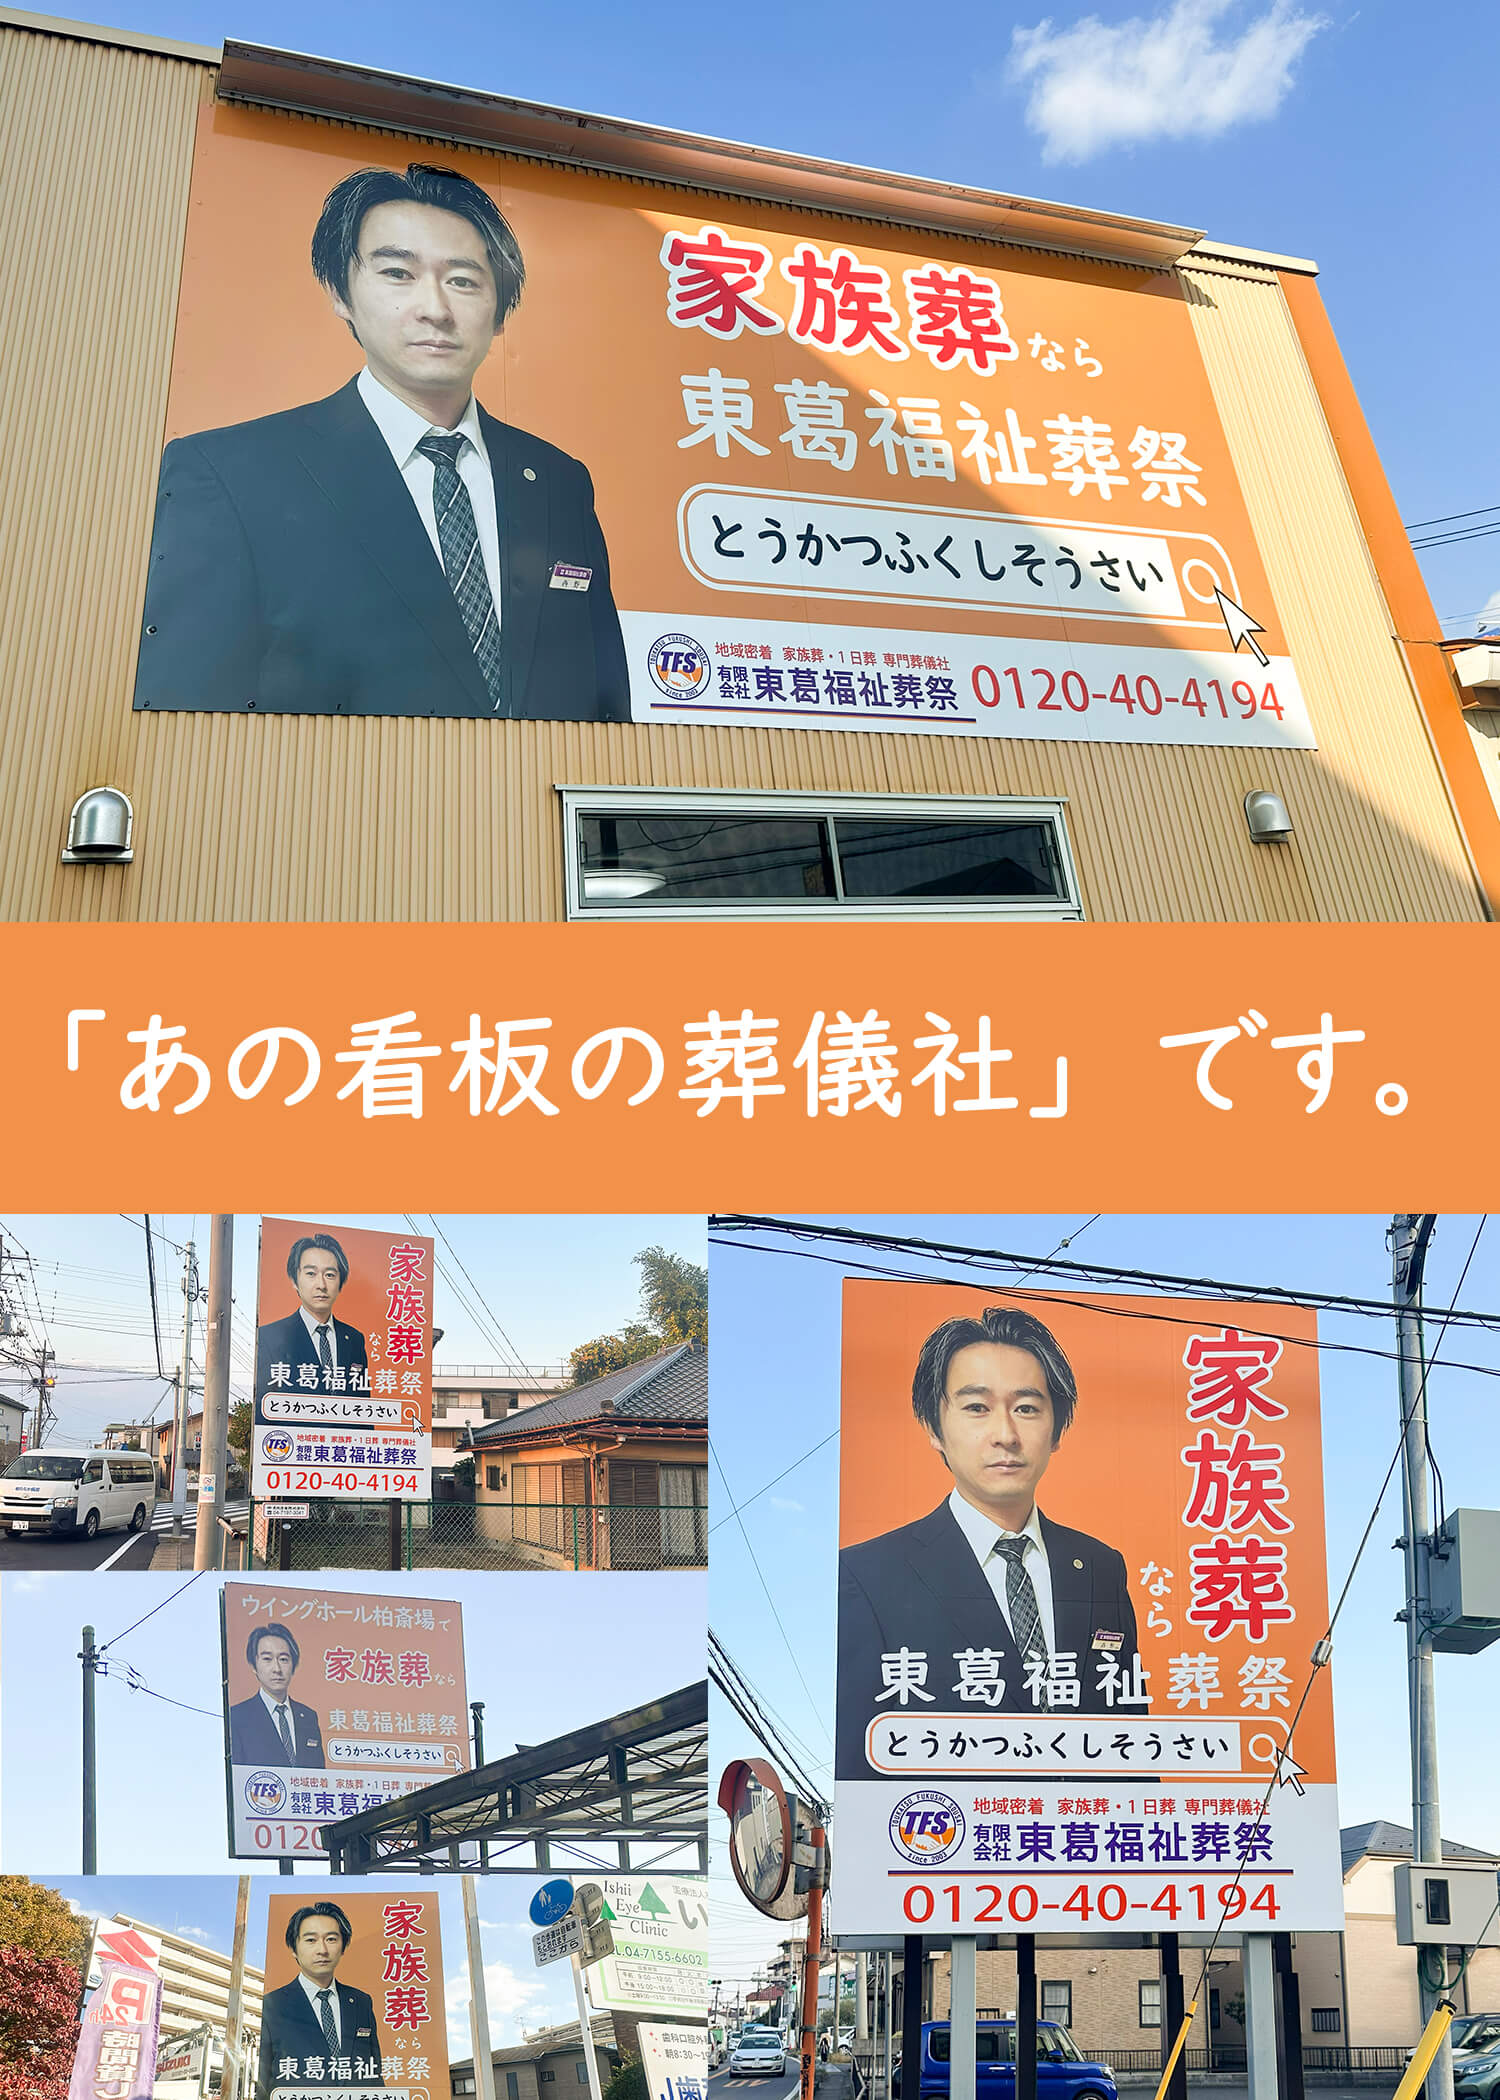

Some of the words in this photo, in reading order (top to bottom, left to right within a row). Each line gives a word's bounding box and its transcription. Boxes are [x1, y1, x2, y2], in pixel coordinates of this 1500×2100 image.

[660, 226, 1018, 376] 家族葬
[1027, 331, 1104, 378] なら
[676, 367, 1207, 509] 東葛福祉葬祭
[710, 513, 1165, 594] とうかつふくしそうさい
[660, 651, 697, 673] TFS
[715, 641, 773, 661] 地域密着
[883, 652, 951, 671] 専門葬儀社
[717, 665, 749, 683] 有限
[719, 682, 750, 700] 会社
[751, 665, 960, 711] 東葛福祉葬祭
[971, 664, 1285, 721] 0120-40-4194
[386, 1241, 427, 1366] 家族葬
[369, 1332, 382, 1362] なら
[267, 1361, 424, 1395] 東葛福祉葬祭
[269, 1400, 398, 1418] とうかつふくしそうさい
[267, 1438, 288, 1450] TFS
[313, 1444, 417, 1465] 東葛福祉葬祭
[266, 1471, 418, 1492] 0120-40-4194
[1182, 1327, 1296, 1643] 家族葬
[1138, 1560, 1175, 1639] なら
[323, 1645, 432, 1689] 家族葬
[433, 1672, 457, 1687] なら
[874, 1647, 1293, 1711] 東葛福祉葬祭
[327, 1708, 458, 1736] 東葛福祉葬祭
[333, 1745, 443, 1761] とうかつふくしそうさい
[887, 1730, 1230, 1761] とうかつふくしそうさい
[252, 1782, 278, 1798] TFS
[290, 1776, 329, 1789] 地域密着
[290, 1791, 312, 1804] 有限
[290, 1803, 312, 1815] 会社
[314, 1791, 403, 1816] 東葛福
[973, 1797, 1045, 1816] 地域密着
[1185, 1797, 1271, 1816] 専門葬儀社
[892, 1798, 913, 1827] TOUKATSU
[916, 1793, 947, 1804] FUKUSHI
[948, 1803, 963, 1826] SOUSAI
[904, 1811, 951, 1835] TFS
[973, 1822, 1011, 1842] 有限
[973, 1842, 1011, 1861] 会社
[1016, 1821, 1274, 1863] 東葛福祉葬祭
[908, 1852, 928, 1864] since
[604, 1880, 632, 1897] Ishii
[616, 1898, 640, 1916] Eye
[902, 1884, 1281, 1923] 0120-40-4194
[630, 1919, 669, 1938] Clinic
[382, 1900, 431, 2031] 家族葬
[394, 2036, 422, 2050] なら
[156, 2054, 192, 2074] SUZUKI
[275, 2055, 431, 2081] 東葛福祉葬祭
